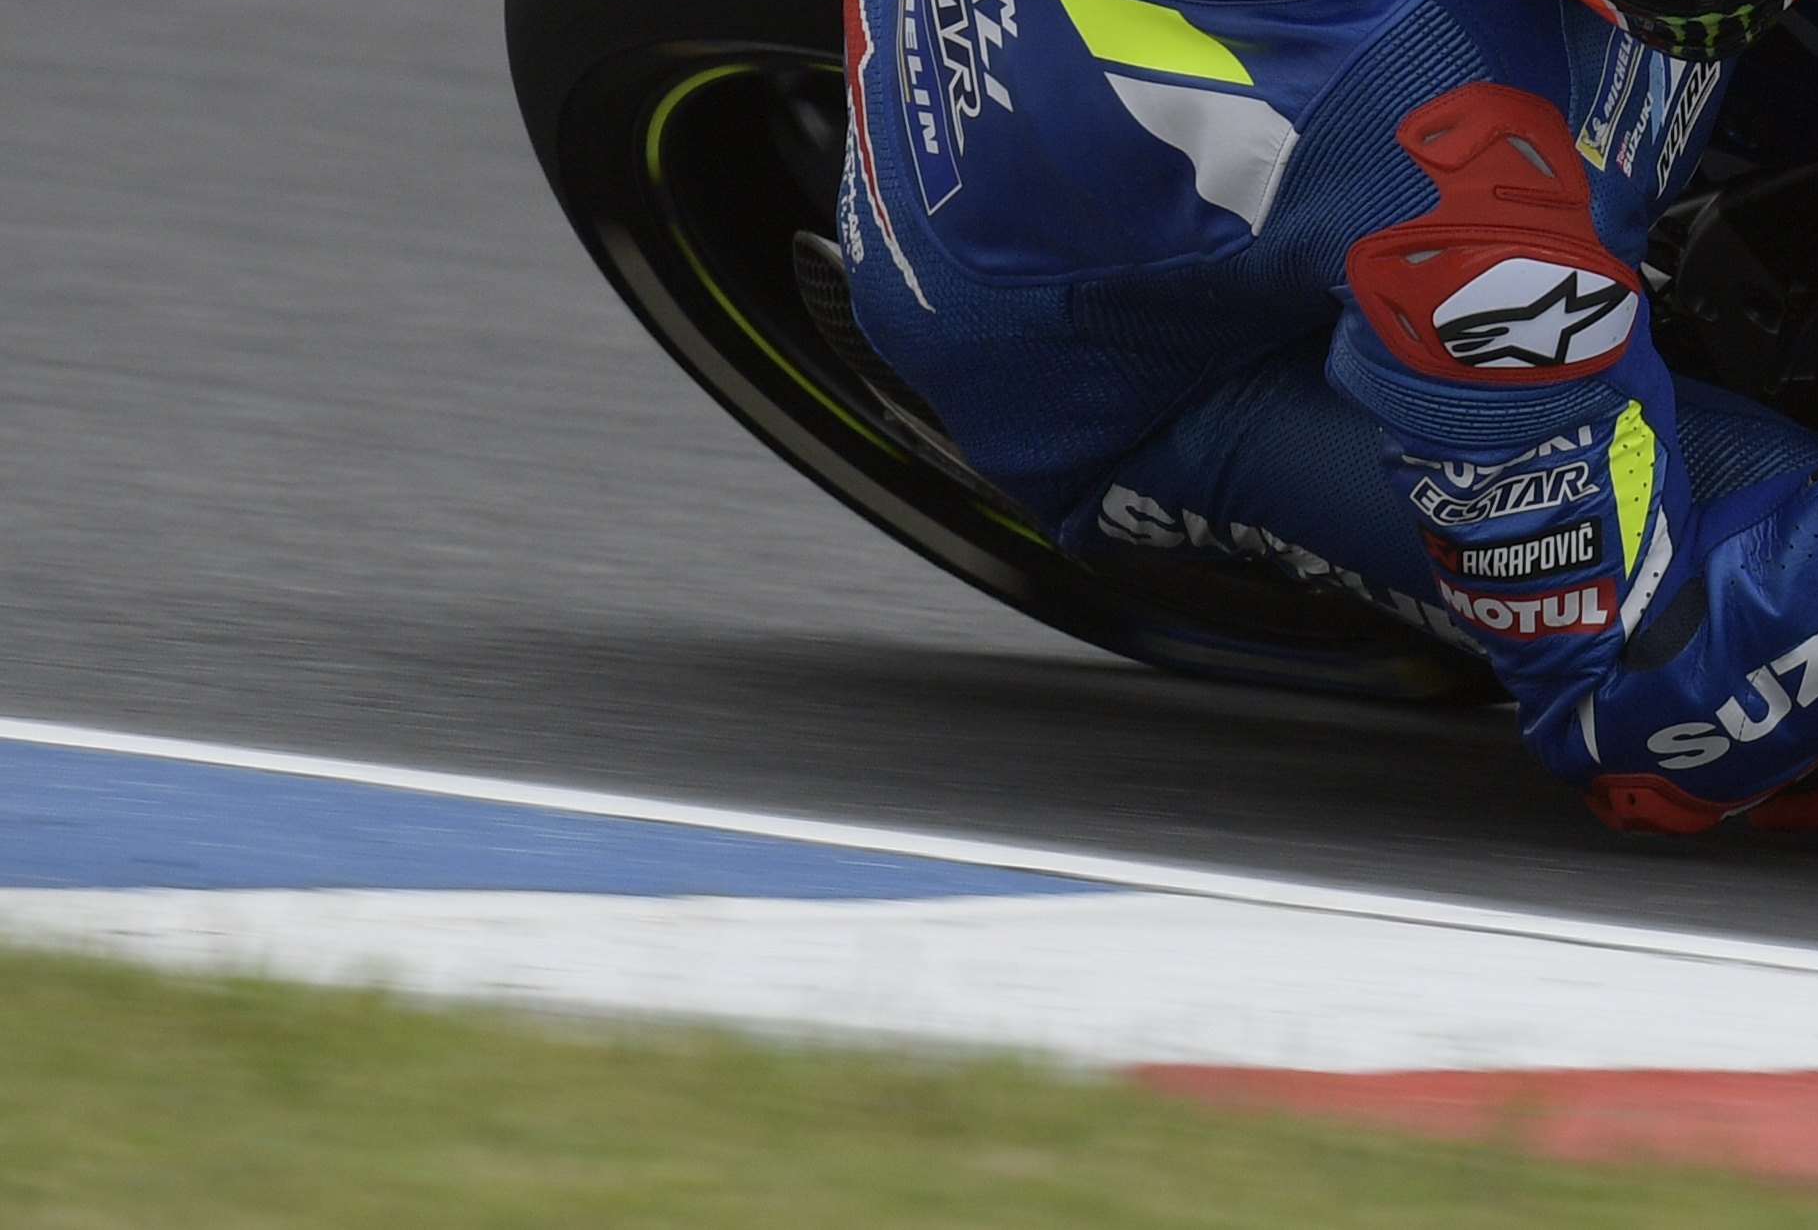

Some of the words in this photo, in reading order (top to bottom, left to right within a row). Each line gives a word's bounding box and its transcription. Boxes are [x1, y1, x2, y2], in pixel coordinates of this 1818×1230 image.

[1622, 91, 1655, 179] SUZUKI
[1409, 461, 1601, 527] ECSTAR
[1462, 522, 1594, 578] AKRAPOVIČ
[1440, 579, 1608, 634] MOTUL
